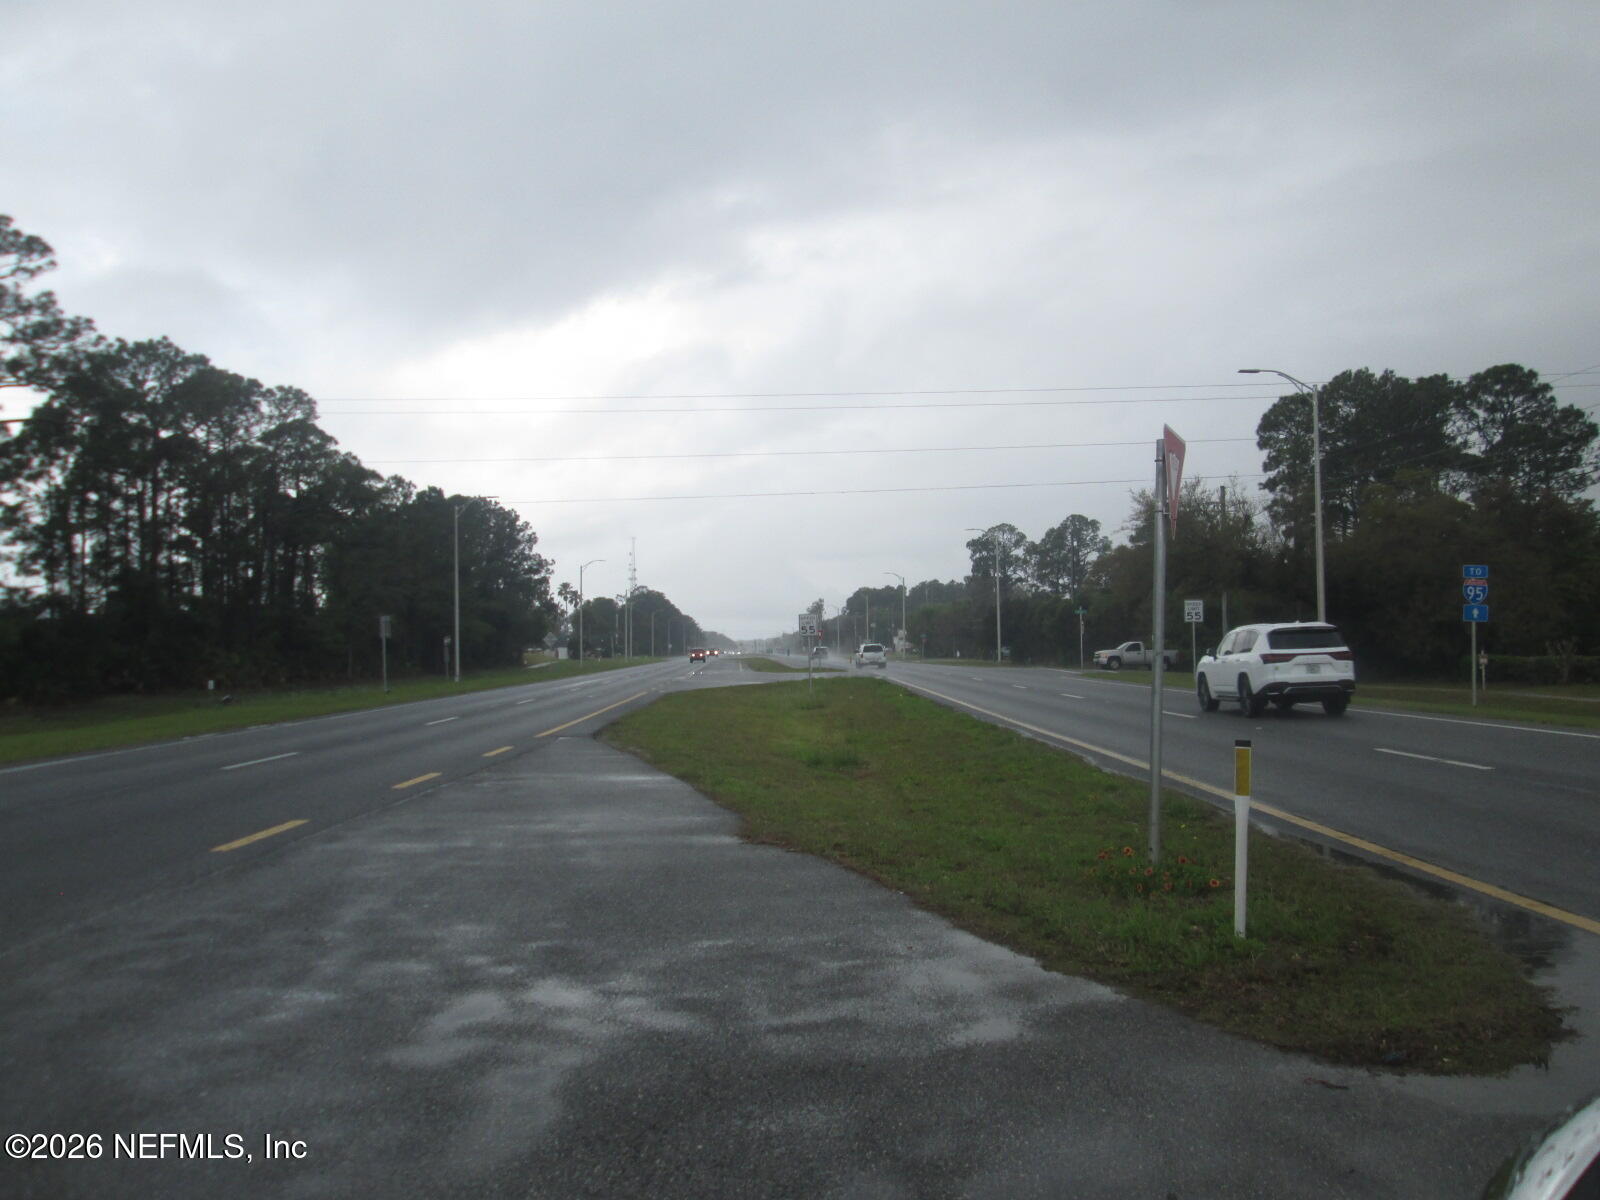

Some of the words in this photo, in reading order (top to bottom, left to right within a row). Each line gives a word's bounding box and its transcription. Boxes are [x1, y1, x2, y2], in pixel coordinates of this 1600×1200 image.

[1470, 567, 1482, 576] TO
[1467, 586, 1483, 600] 95
[1186, 611, 1202, 621] 55
[801, 625, 816, 635] 55
